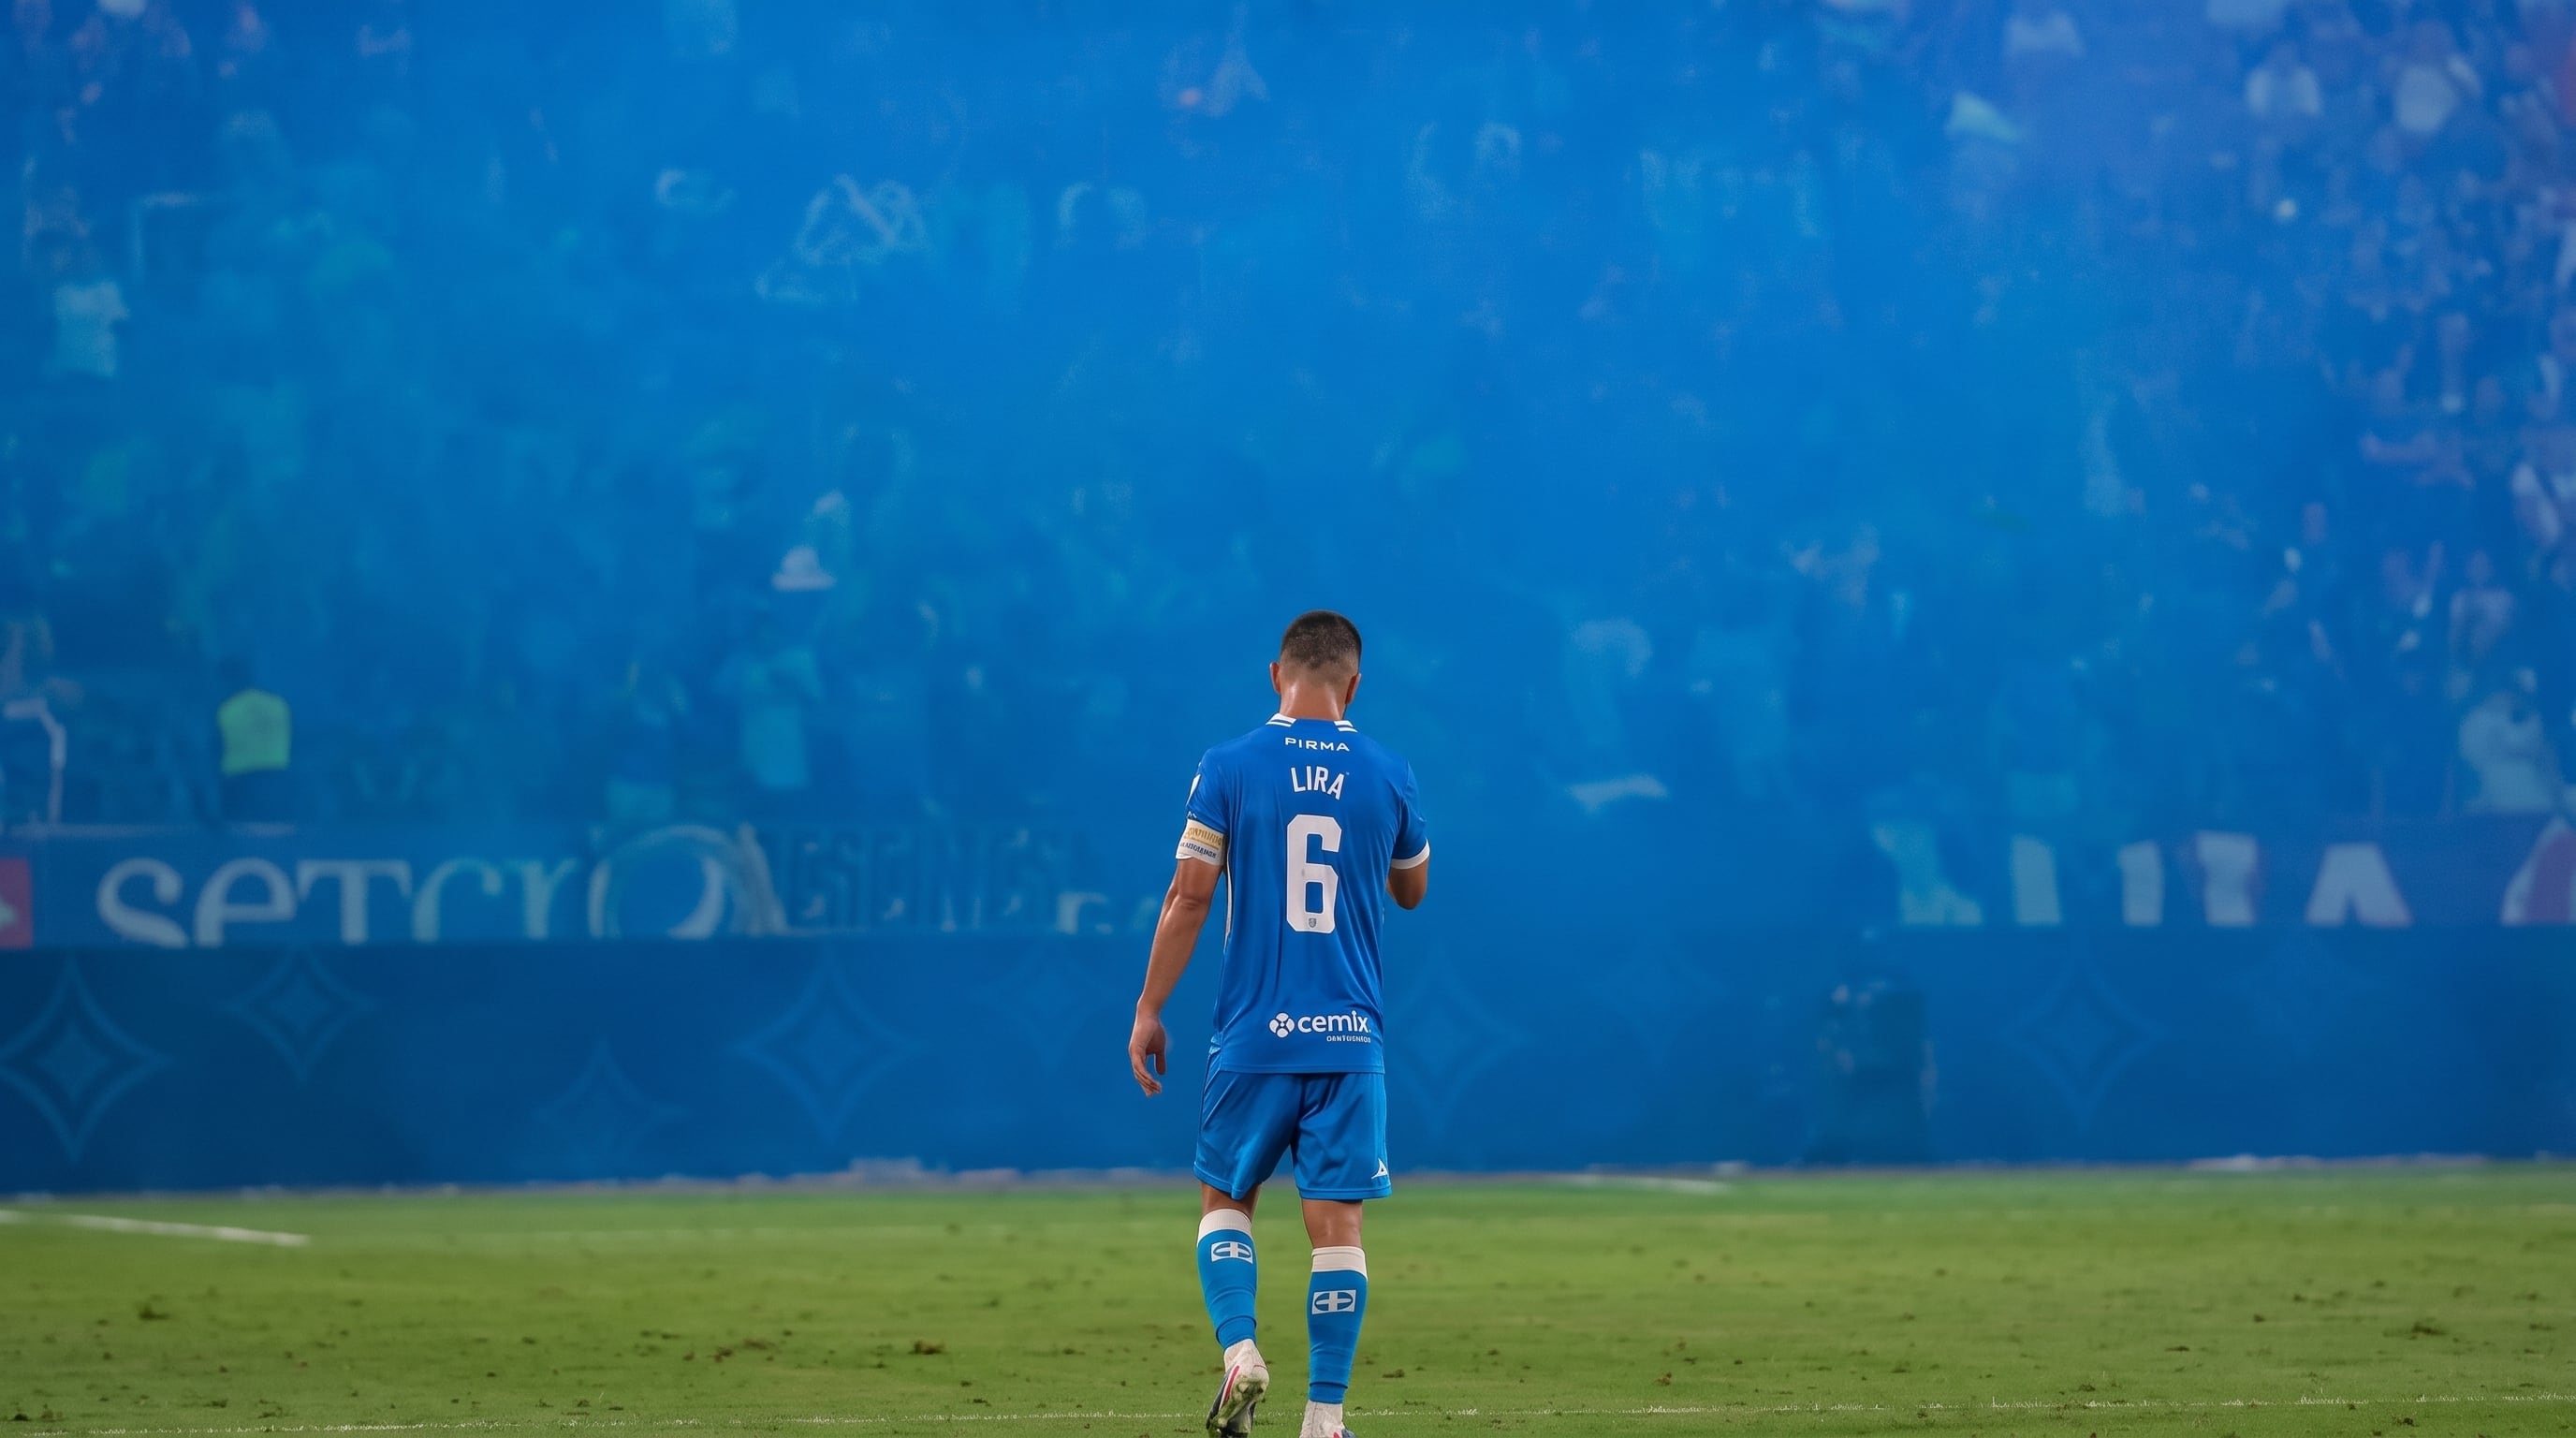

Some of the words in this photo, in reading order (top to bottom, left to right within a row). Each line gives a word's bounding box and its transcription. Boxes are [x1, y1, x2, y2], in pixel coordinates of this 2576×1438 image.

[1285, 737, 1350, 752] PIRMA
[1291, 765, 1345, 800] LIRA
[1287, 814, 1342, 933] 6
[1297, 1010, 1368, 1033] cemix
